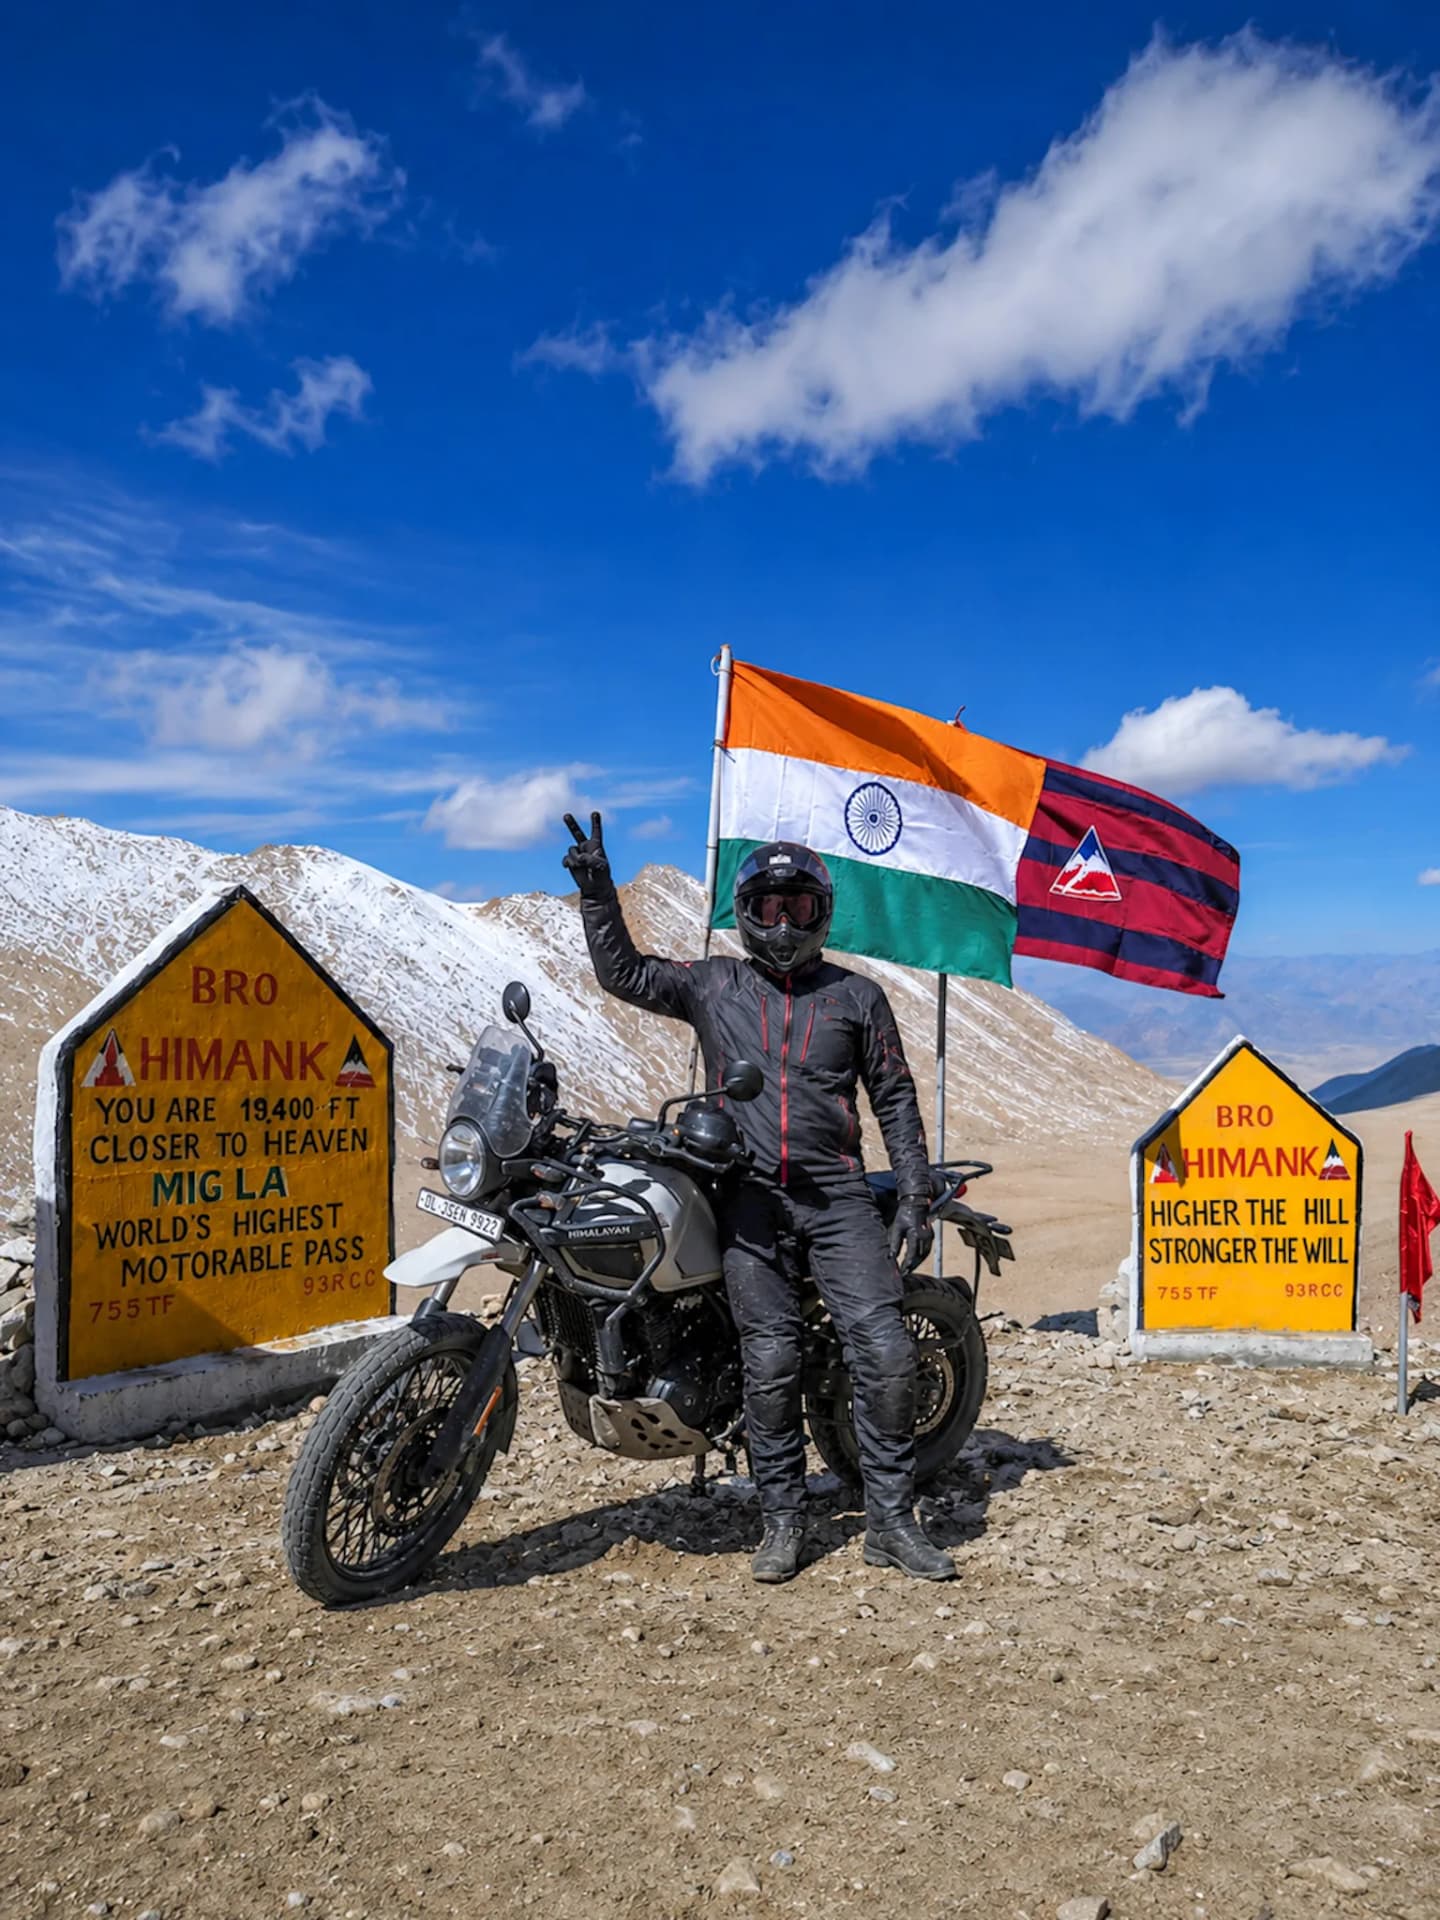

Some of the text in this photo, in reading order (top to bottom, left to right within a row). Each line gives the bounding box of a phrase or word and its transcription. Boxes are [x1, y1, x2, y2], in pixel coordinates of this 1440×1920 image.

[192, 966, 278, 1006] BRO
[140, 1036, 329, 1081] HIMANK
[95, 1097, 155, 1125] YOU
[166, 1097, 216, 1123] ARE
[329, 1097, 360, 1120] FT
[1216, 1104, 1274, 1128] BRO
[90, 1127, 368, 1164] CLOSER TO HEAVEN
[1183, 1146, 1319, 1179] HIMANK
[152, 1165, 289, 1208] MIG LA
[92, 1202, 344, 1250] WORLD'S HIGHEST
[470, 1211, 498, 1236] 9922
[1150, 1198, 1349, 1227] HIGHER THE HILL
[567, 1225, 631, 1239] HIMALAYAN
[121, 1235, 365, 1288] MOTORABLE PASS
[1149, 1236, 1349, 1264] STRONGER THE WILL
[303, 1268, 376, 1296] 93RCC
[1284, 1282, 1344, 1298] 93RCC
